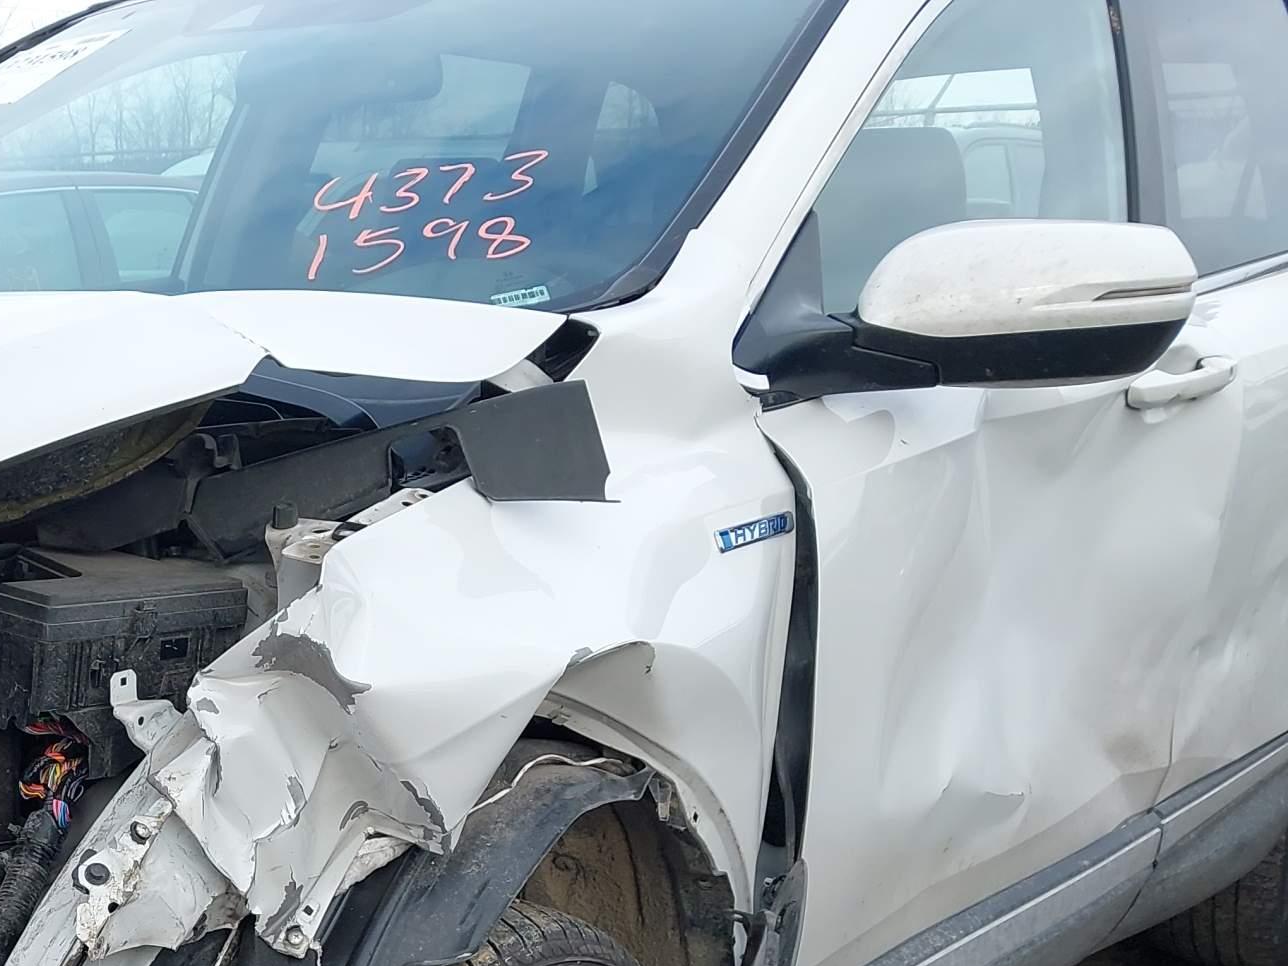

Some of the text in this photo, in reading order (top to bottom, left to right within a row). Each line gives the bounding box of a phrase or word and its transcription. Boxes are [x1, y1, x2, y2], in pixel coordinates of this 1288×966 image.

[312, 148, 550, 221] 4373
[306, 215, 532, 281] 1598
[734, 516, 788, 545] HYBRID
